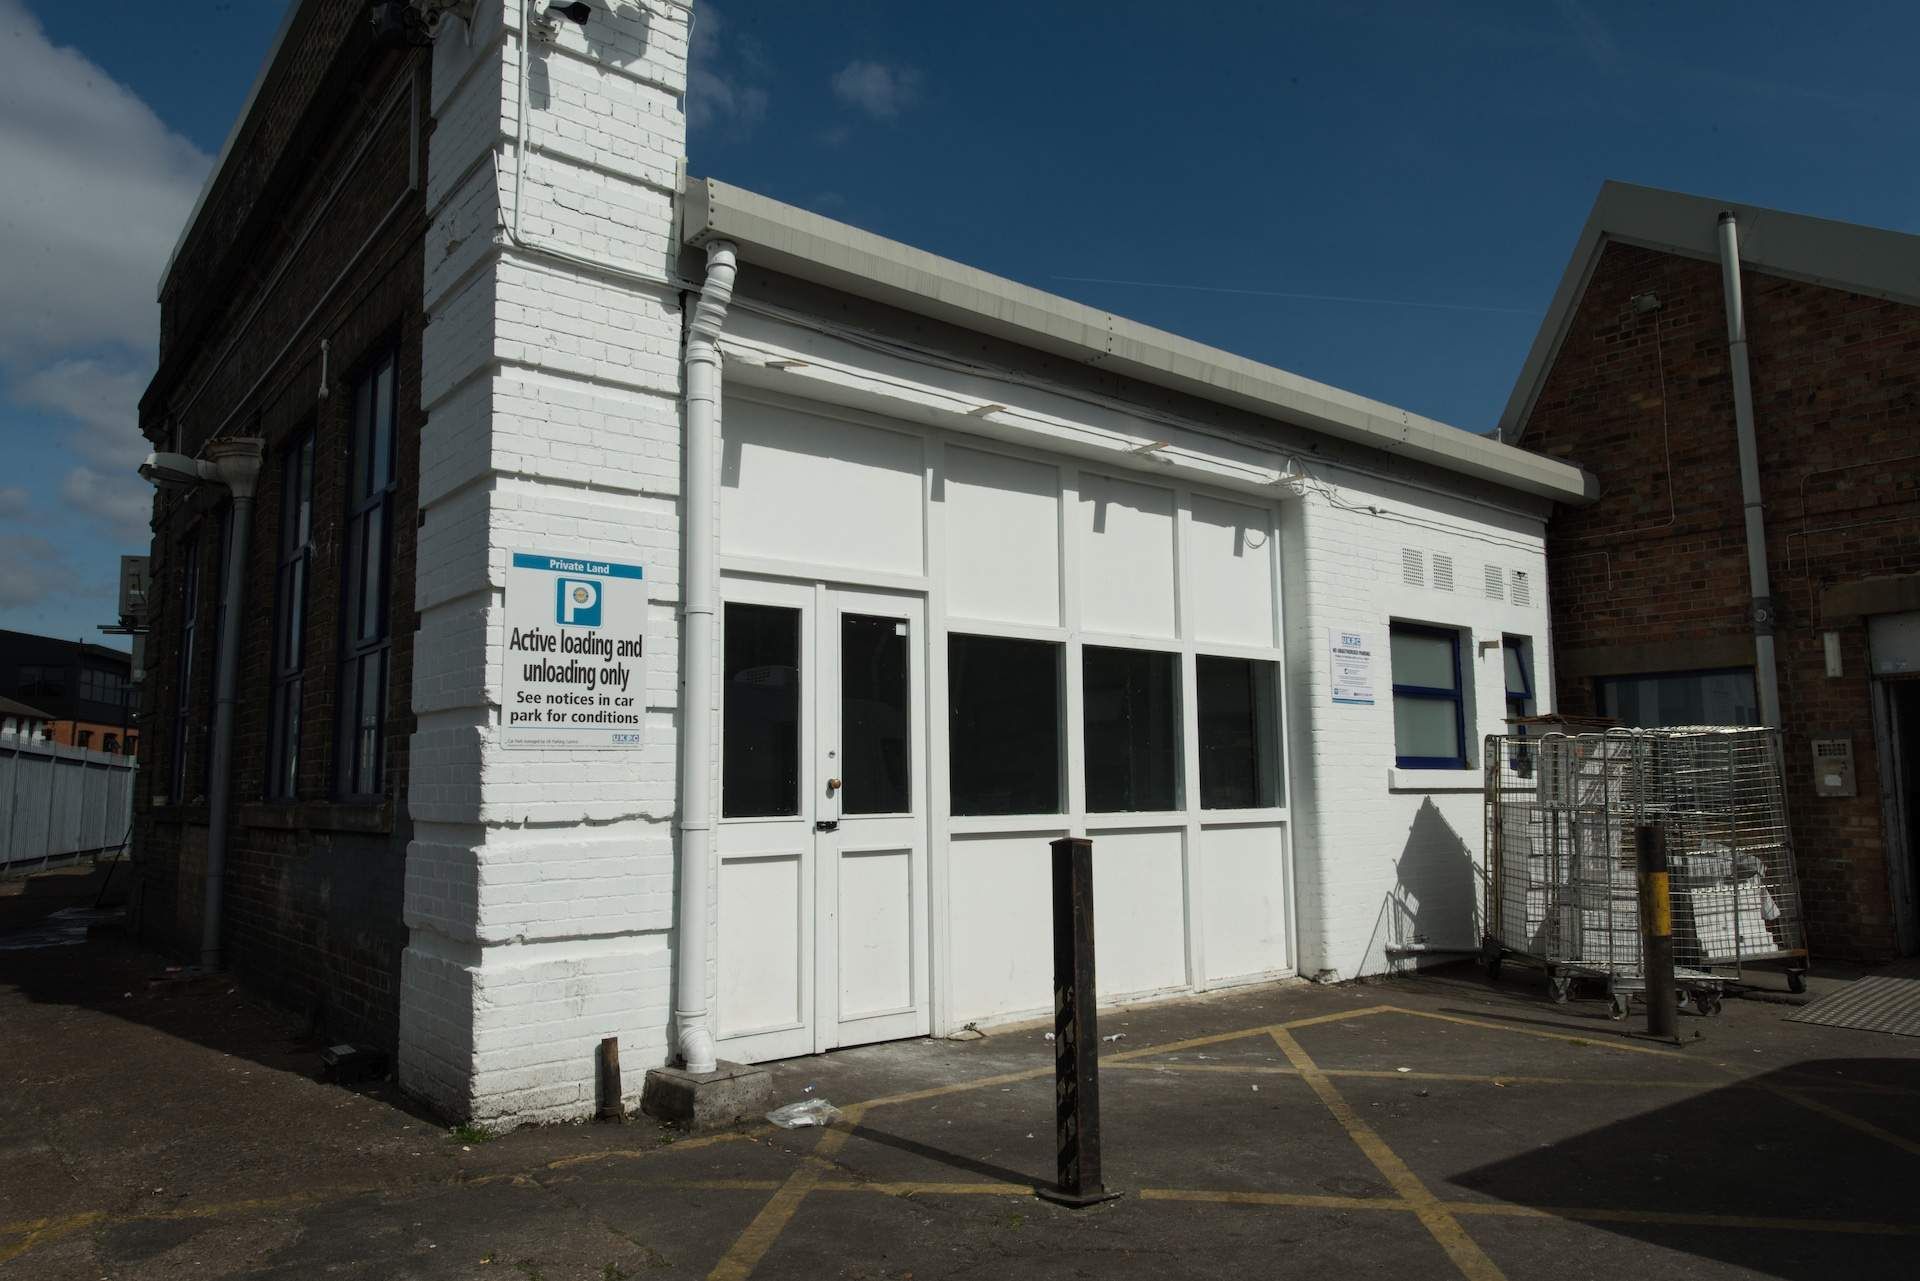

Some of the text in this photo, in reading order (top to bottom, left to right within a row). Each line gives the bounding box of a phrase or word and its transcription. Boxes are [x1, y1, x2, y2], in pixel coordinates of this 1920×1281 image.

[549, 559, 610, 574] Private Land
[564, 580, 597, 622] P
[509, 627, 642, 662] Active loading and
[523, 657, 630, 692] unloading only
[516, 690, 635, 707] See notices in car
[510, 708, 639, 725] park for conditions
